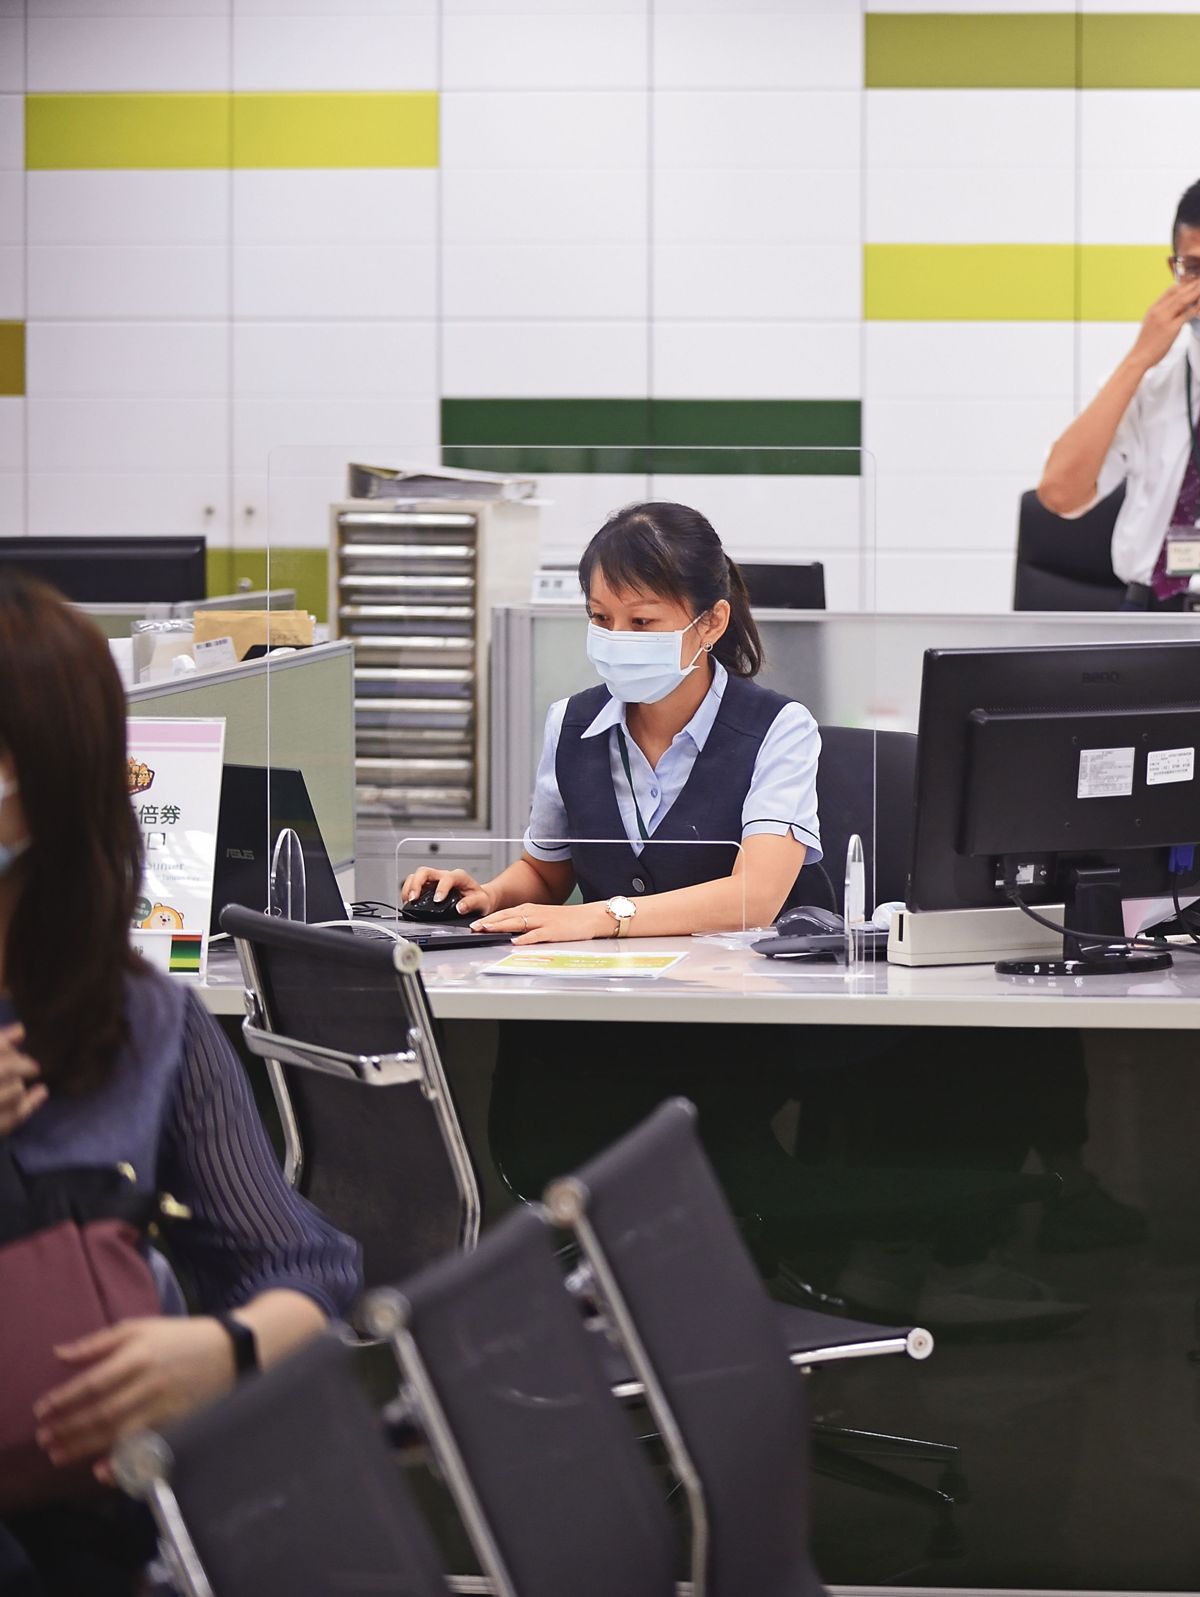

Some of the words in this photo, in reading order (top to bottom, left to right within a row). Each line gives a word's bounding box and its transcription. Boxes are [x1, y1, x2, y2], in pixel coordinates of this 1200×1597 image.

[132, 804, 181, 825] 倍券
[141, 831, 166, 851] 口
[226, 847, 255, 861] ASUS
